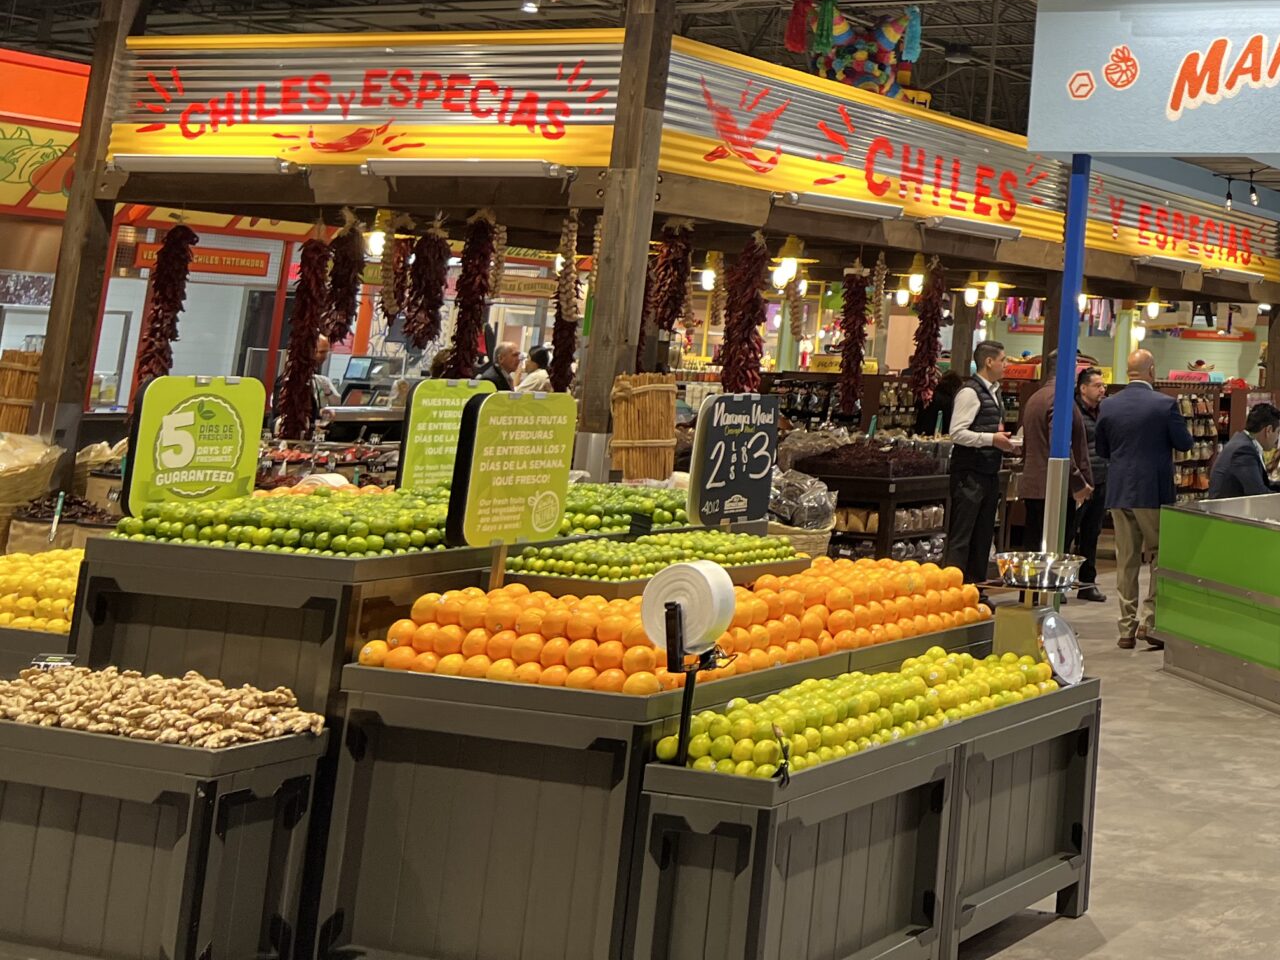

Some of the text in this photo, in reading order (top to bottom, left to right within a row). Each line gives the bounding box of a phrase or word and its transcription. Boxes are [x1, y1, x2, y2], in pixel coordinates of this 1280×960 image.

[179, 73, 333, 140] CHILES
[359, 68, 571, 140] ESPECIAS
[864, 136, 1019, 222] CHILES
[1137, 203, 1253, 266] ESPECIAS
[193, 255, 219, 265] CHILES
[422, 398, 461, 407] NUESTRAS
[489, 415, 568, 426] NUESTRAS FRUTAS
[713, 401, 750, 432] Naranja
[222, 424, 235, 433] DE
[417, 422, 428, 431] SE
[161, 410, 196, 469] 5
[434, 435, 445, 443] DE
[446, 435, 455, 443] LA
[501, 430, 554, 440] Y VERDURAS
[196, 445, 234, 455] DAYS OF
[482, 444, 567, 456] SE ENTREGAN LOS 7
[479, 459, 566, 472] DÍAS DE LA SEMANA.
[705, 440, 726, 490] 2
[155, 469, 235, 486] GUARANTEED
[491, 472, 551, 486] ¡QUÉ FRESCO!
